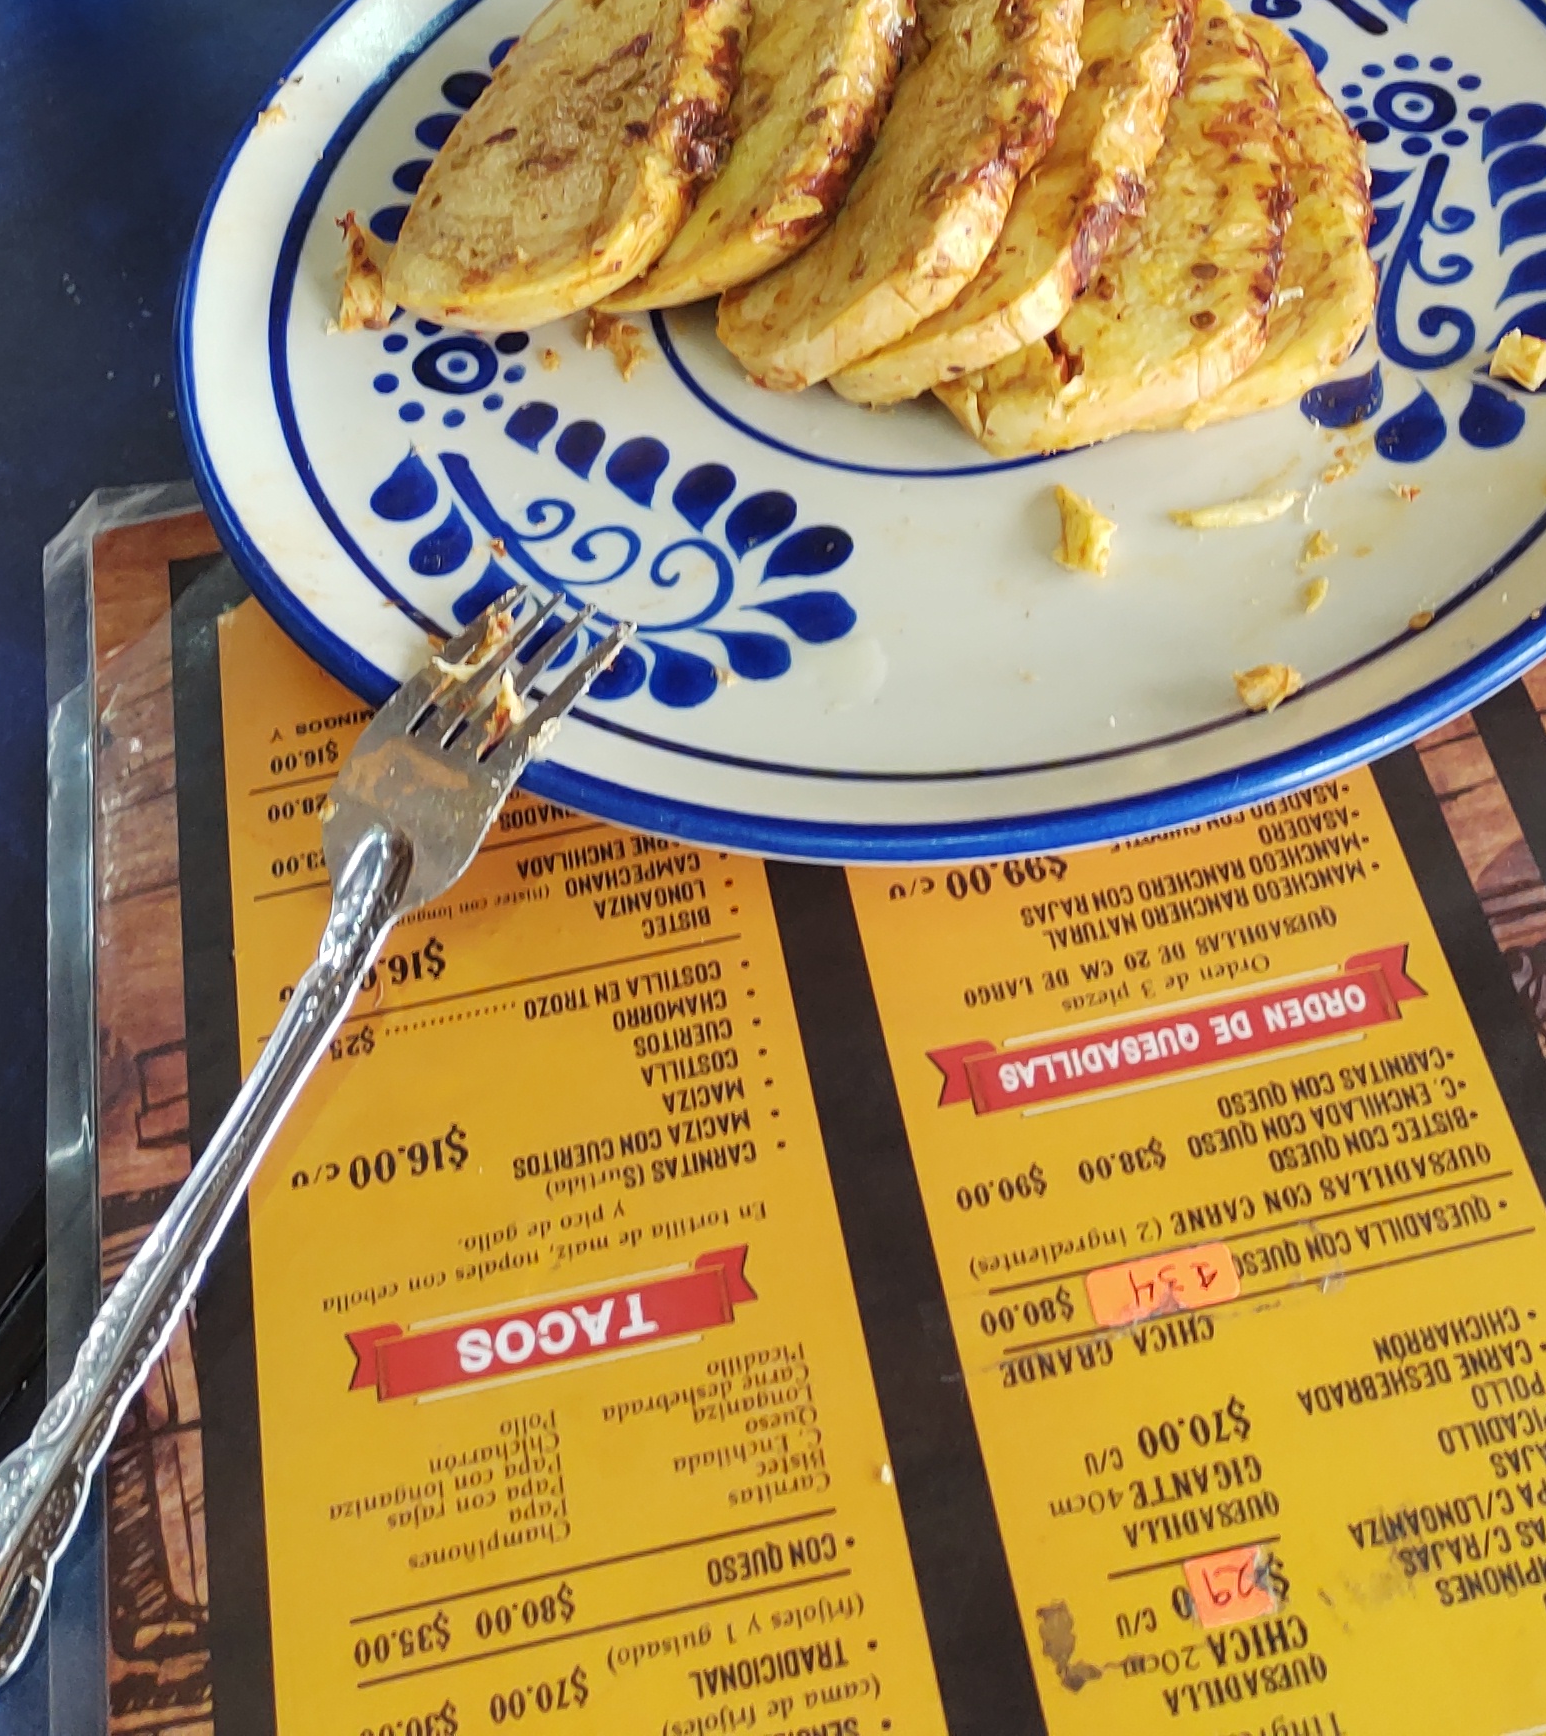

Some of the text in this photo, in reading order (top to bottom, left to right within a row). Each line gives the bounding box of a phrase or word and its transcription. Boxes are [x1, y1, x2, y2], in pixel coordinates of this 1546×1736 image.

[269, 741, 341, 775] $16.00
[1257, 806, 1348, 844] ASADERO
[564, 852, 700, 897] CAMPECHANO
[945, 841, 1067, 899] $99.00
[1019, 831, 1360, 926] MANCHEGO RANCHERO CON RAJAS
[593, 878, 705, 919] LONGANIZA
[641, 906, 711, 937] BISTEC
[1046, 859, 1365, 950] MANCHEGO RANCHERO NATURAL
[963, 906, 1337, 1006] QUESADILLAS DE 20 CM DE LARGO
[1199, 955, 1269, 980] Orden
[523, 960, 721, 1019] COSTILLA EN TROZO
[1060, 980, 1129, 1011] piezas
[1164, 972, 1189, 991] de
[612, 989, 727, 1030] CHAMORRO
[632, 1018, 732, 1056] CUERITOS
[998, 984, 1365, 1091] ORDEN DE QUESADILLAS
[640, 1047, 738, 1086] COSTILLA
[661, 1077, 744, 1114] MACIZA
[1308, 1082, 1431, 1129] ENCHILADA
[512, 1108, 750, 1179] MACIZA CON CUERITOS
[1186, 1120, 1257, 1157] QUESO
[1260, 1112, 1306, 1140] CON
[1267, 1106, 1469, 1171] BISTEC CON QUESO
[348, 1123, 468, 1189] $16.00
[650, 1140, 756, 1182] CARNITAS
[1077, 1136, 1166, 1183] $38.00
[955, 1162, 1047, 1209] $90.00
[1169, 1142, 1490, 1234] QUESADILLAS CON CARNE
[618, 1228, 642, 1247] de
[650, 1209, 728, 1239] tortilla
[408, 1271, 446, 1291] con
[454, 1250, 538, 1281] nopales
[979, 1195, 1491, 1335] QUESADILLA CON $80.00
[322, 1282, 398, 1313] cebolla
[455, 1292, 657, 1372] TACOS
[998, 1313, 1214, 1386] CHICA GRANDE
[1372, 1307, 1520, 1363] CHICHARRÓN
[1296, 1339, 1532, 1415] CARNE DESHEBRADA
[1470, 1370, 1545, 1409] POLLO
[499, 1409, 555, 1438] Pollo
[744, 1404, 817, 1432] Queso
[1136, 1395, 1250, 1458] $70.00
[760, 1447, 825, 1475] Bistec
[1128, 1454, 1261, 1508] GIGANTE
[386, 1474, 564, 1527] Papa con rajas
[727, 1472, 830, 1504] Carnitas
[1122, 1490, 1279, 1548] QUESADILLA
[1347, 1488, 1514, 1549] C/LONGANIZA
[1396, 1526, 1511, 1577] C/RAJAS
[353, 1534, 836, 1667] CON QUESO $80.00 $35.00
[1206, 1616, 1307, 1666] CHICA
[488, 1639, 847, 1723] TRADICIONAL $70.00
[1162, 1654, 1327, 1715] QUESADILLA
